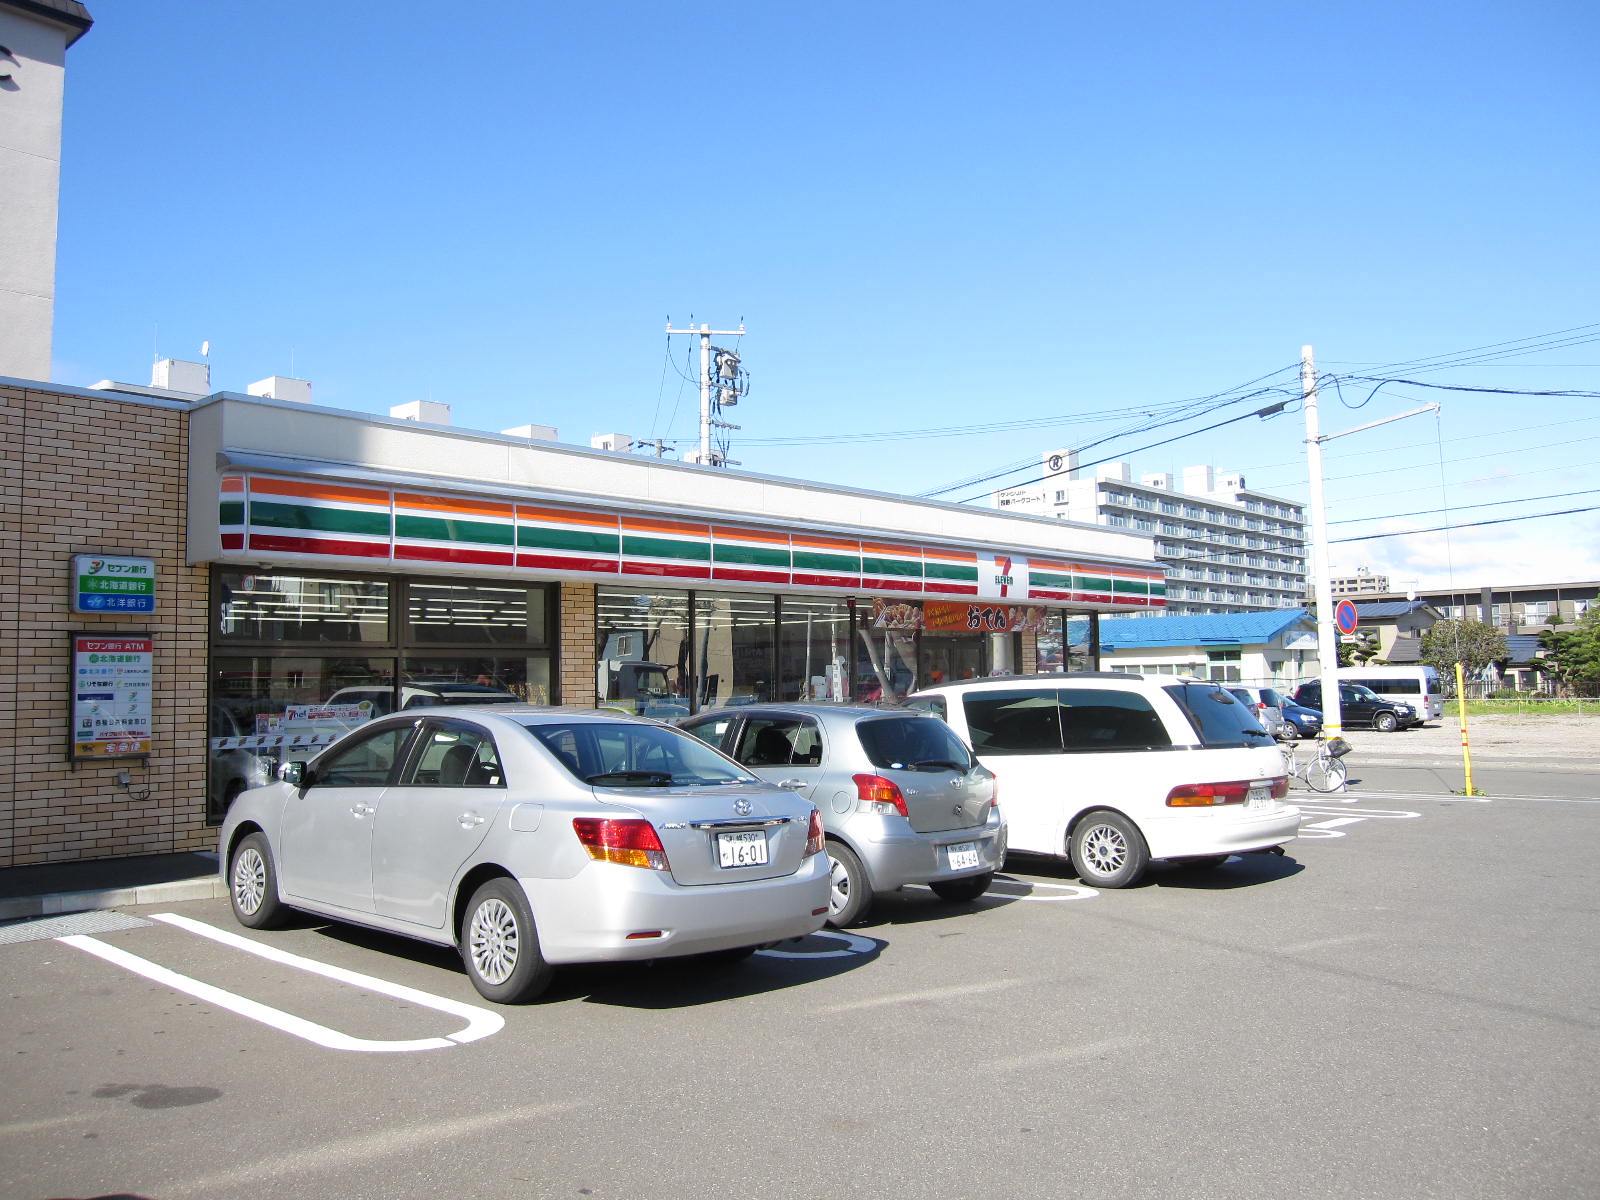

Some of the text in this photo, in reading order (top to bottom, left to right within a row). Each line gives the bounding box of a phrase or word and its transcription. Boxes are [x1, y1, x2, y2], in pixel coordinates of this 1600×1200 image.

[107, 564, 147, 574] セブン銀行
[994, 555, 1012, 597] 7
[100, 580, 146, 591] 北海道銀行
[106, 597, 146, 608] 北洋銀行
[87, 642, 144, 650] セブン銀行 ATM
